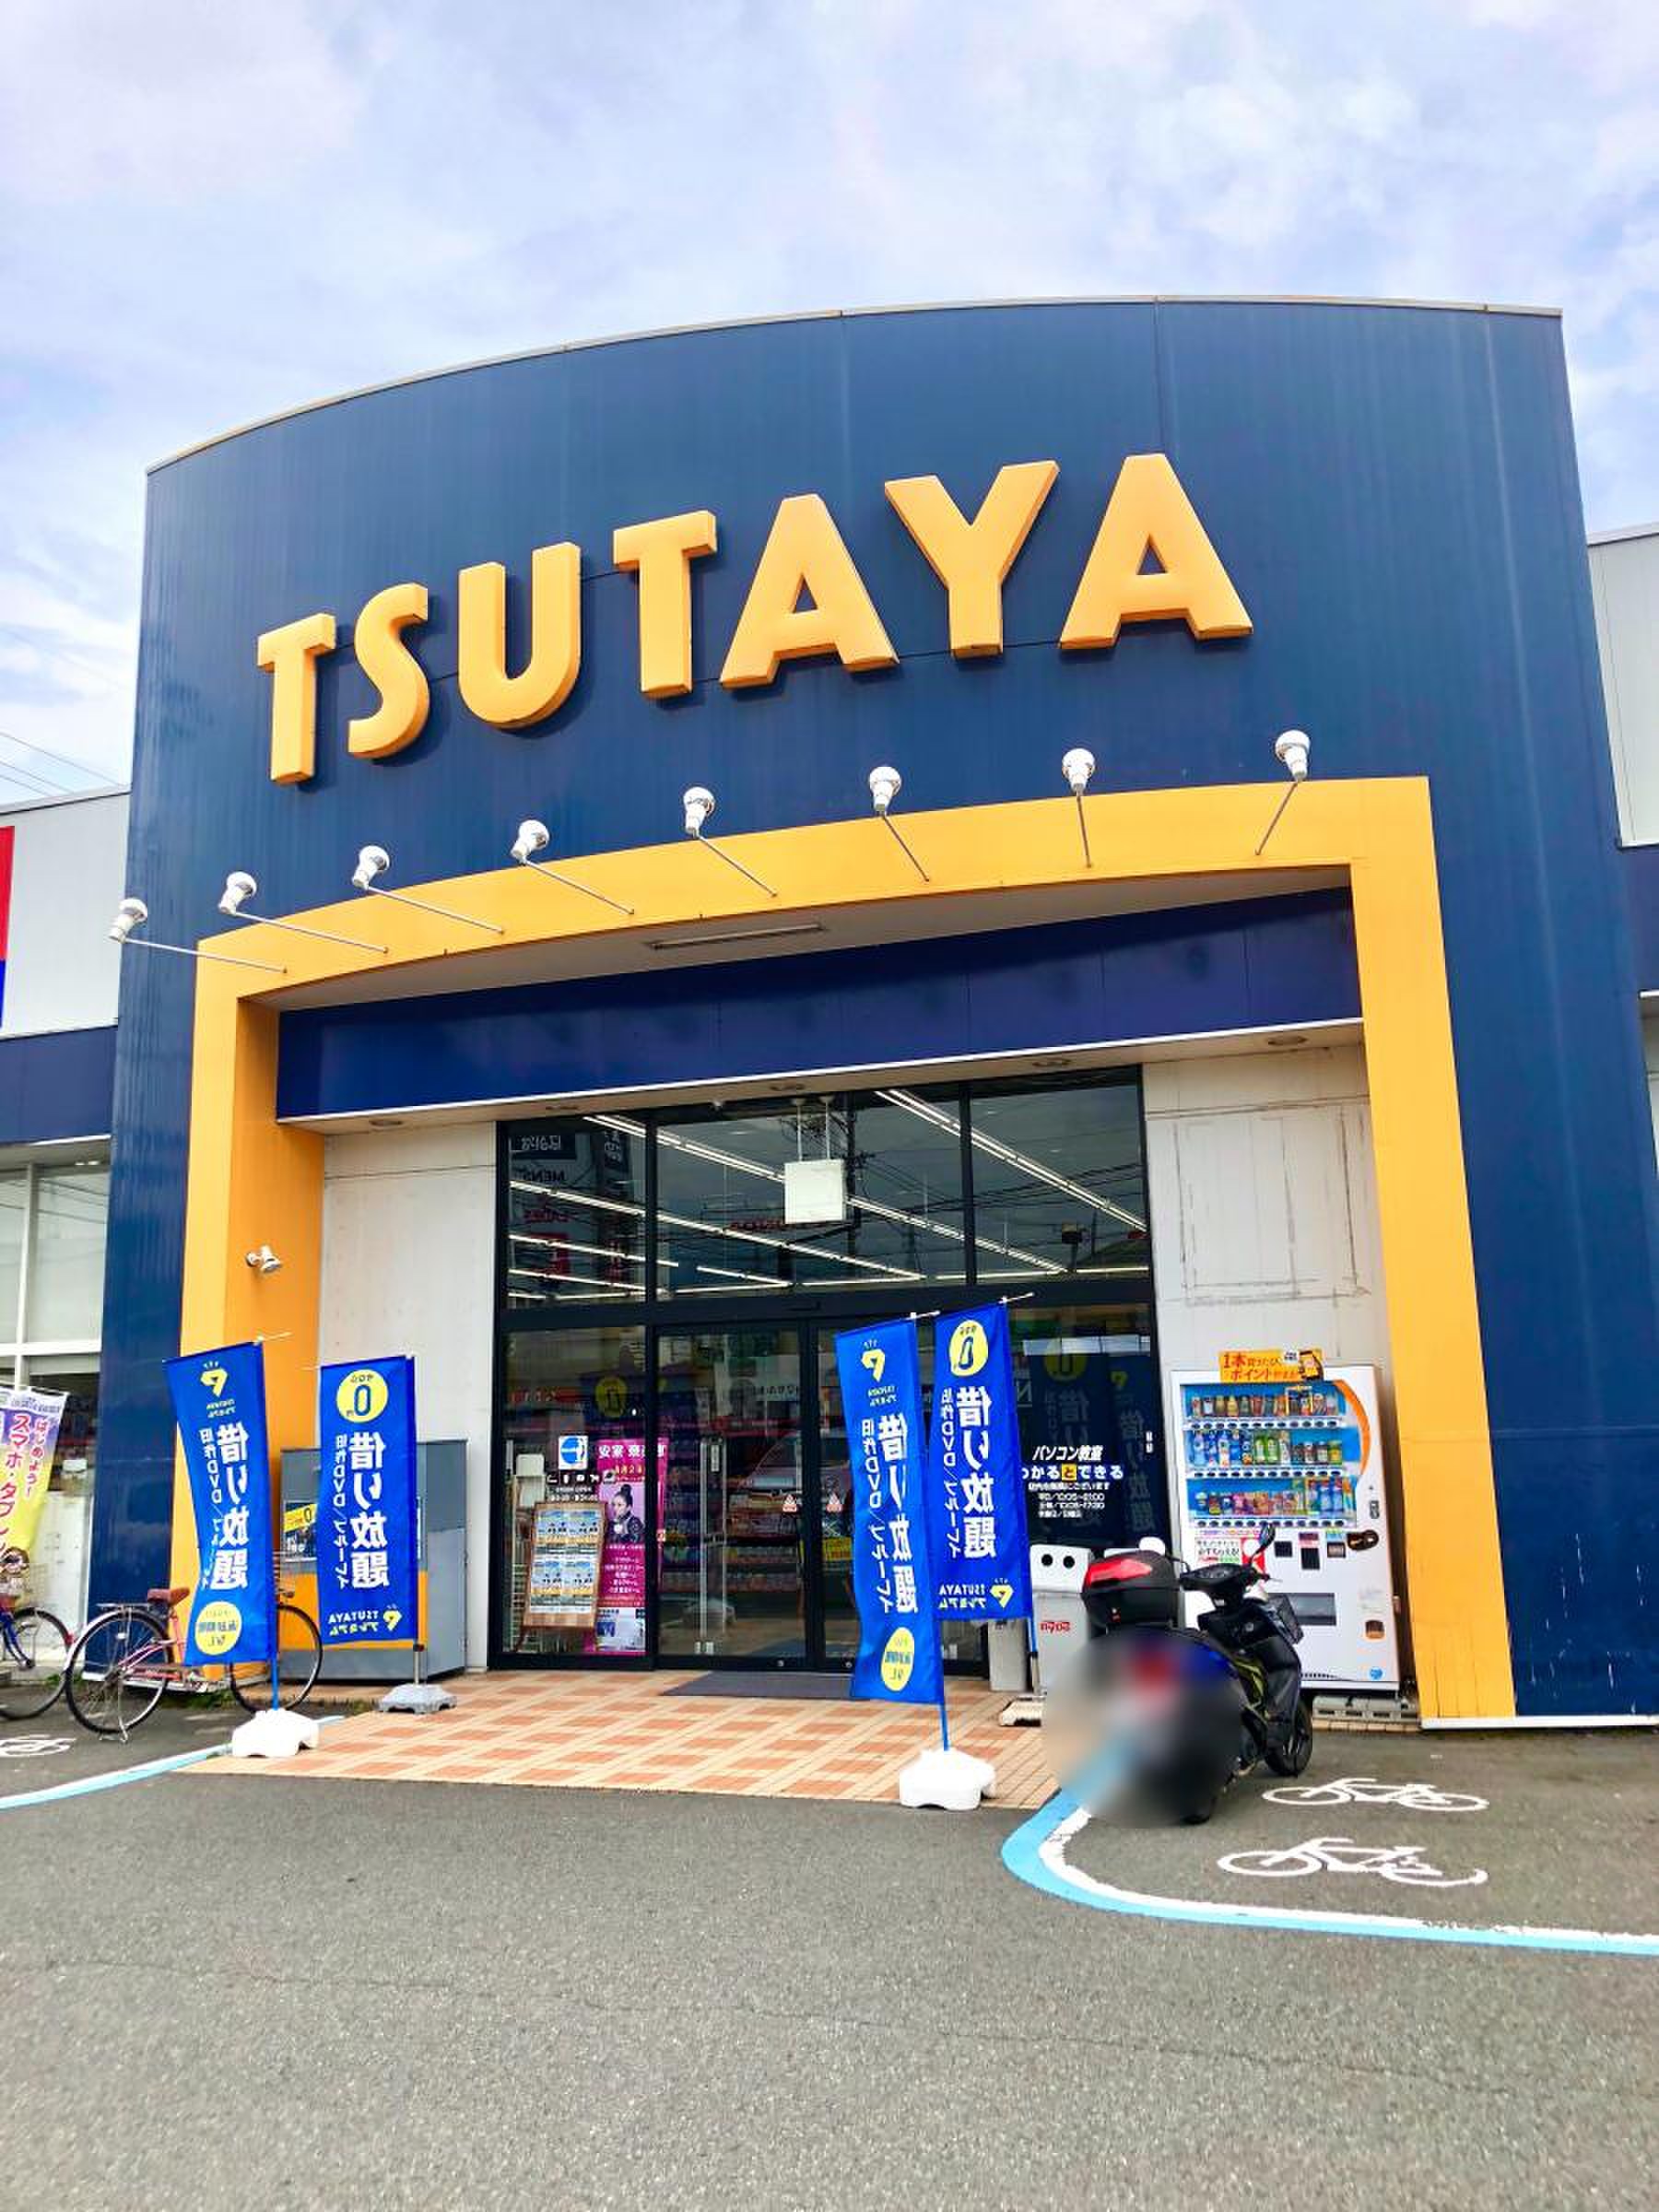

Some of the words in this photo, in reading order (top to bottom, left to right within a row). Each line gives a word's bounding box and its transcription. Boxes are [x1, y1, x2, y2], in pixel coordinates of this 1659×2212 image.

[257, 453, 1253, 785] TSUTAYA
[1032, 1444, 1104, 1461] パソコン教室
